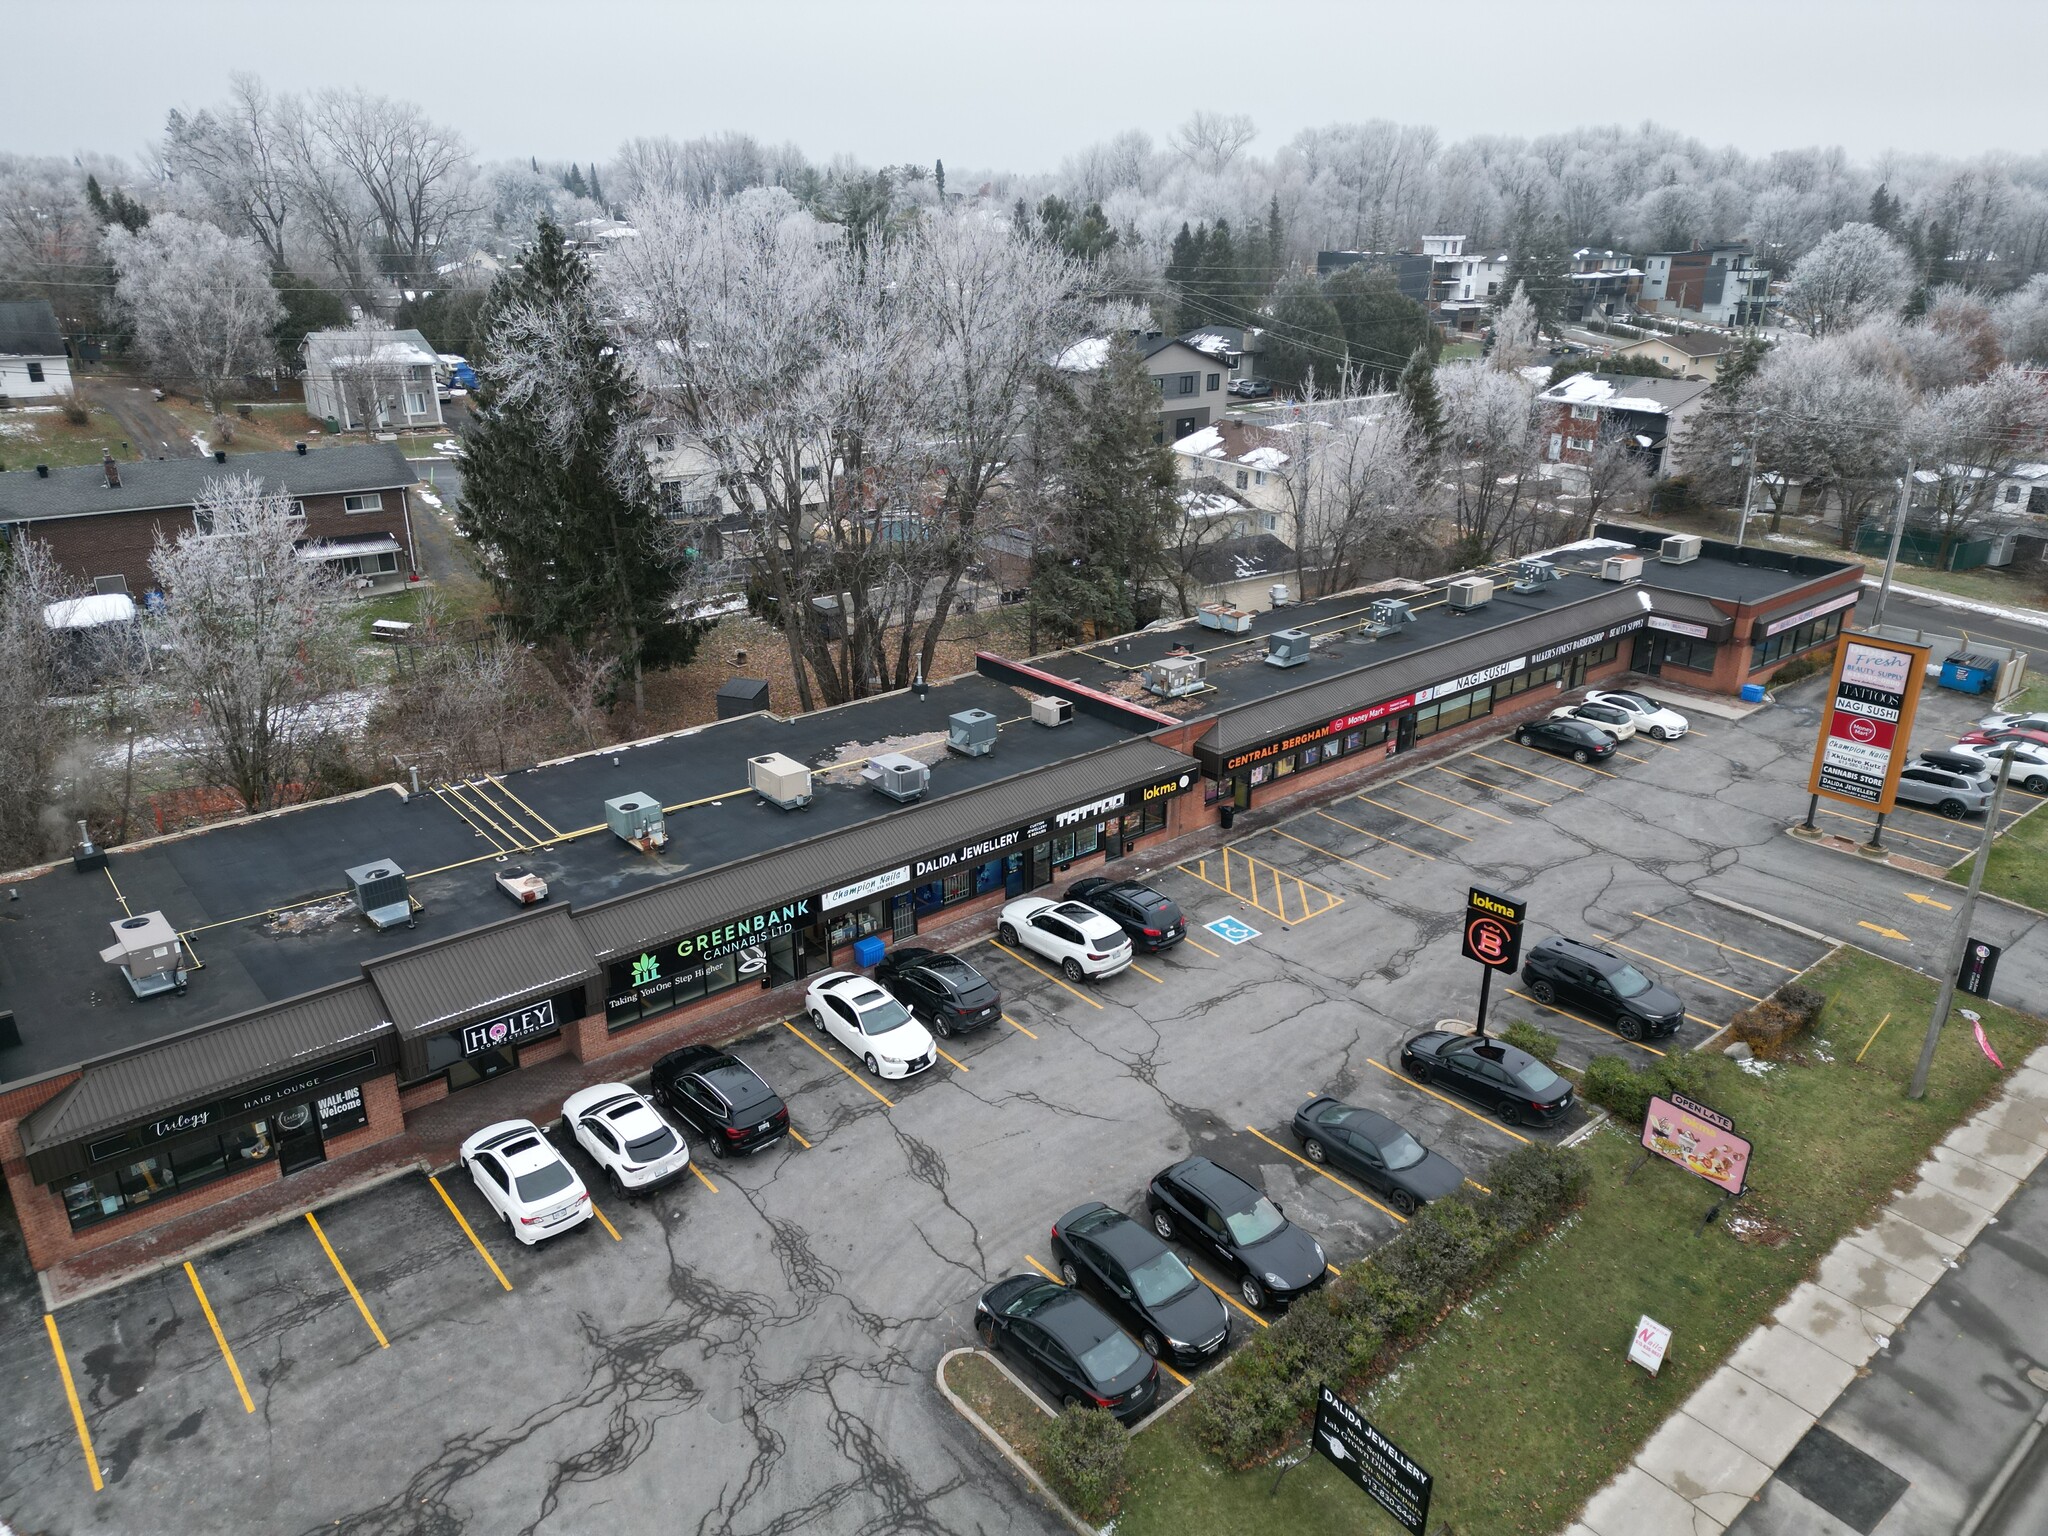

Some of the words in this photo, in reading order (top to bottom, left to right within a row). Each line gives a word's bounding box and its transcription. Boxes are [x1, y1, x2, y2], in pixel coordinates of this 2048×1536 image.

[1847, 664, 1875, 675] BEAUTY
[1877, 670, 1904, 681] SUPPLY
[1856, 654, 1907, 667] Fresh
[1456, 673, 1481, 690] NAGI
[1484, 662, 1511, 680] SUSHI
[1837, 699, 1863, 710] NAGI
[1867, 705, 1897, 719] SUSHI
[1843, 684, 1899, 706] TATTOOS
[1347, 712, 1369, 726] Money
[1369, 707, 1385, 719] Mart
[1853, 723, 1873, 733] Money
[1227, 743, 1279, 770] CENTRALE
[1282, 726, 1330, 751] BERGHAM
[1828, 740, 1866, 755] Champion
[1868, 750, 1889, 761] Nails
[1143, 781, 1177, 800] lokma
[1822, 778, 1844, 788] DALIDA
[1845, 784, 1877, 796] JEWELLERY
[1823, 766, 1858, 780] CANNABIS
[1860, 775, 1883, 787] STORE
[1056, 793, 1125, 828] TATTOO
[916, 852, 957, 876] DALIDA
[960, 831, 1019, 861] JEWELLERY
[832, 880, 876, 901] Champion
[880, 871, 901, 884] Nails
[1473, 892, 1515, 918] lokma
[677, 899, 809, 957] GREENBANK
[703, 931, 767, 961] CANNABIS
[771, 923, 792, 938] LTD
[609, 993, 638, 1009] Taking
[640, 987, 656, 998] You
[656, 981, 672, 992] One
[675, 974, 693, 985] Step
[471, 1006, 547, 1048] HOLEY
[481, 1026, 539, 1050] CONFECTIONS
[244, 1095, 271, 1109] HAIR
[277, 1078, 320, 1098] LOUNGE
[317, 1087, 360, 1109] WALK-INS
[319, 1098, 361, 1119] Welcome
[1675, 1096, 1702, 1113] OPEN
[1704, 1109, 1729, 1127] LATE
[149, 1109, 210, 1137] Trilogy
[1682, 1113, 1717, 1137] lokma
[1324, 1388, 1362, 1430] DALIDA
[1365, 1427, 1428, 1484] JEWELLERY
[1324, 1416, 1340, 1433] Lab
[1341, 1431, 1369, 1460] Grown
[1371, 1457, 1419, 1502] Diamonds!
[1346, 1427, 1366, 1447] Now
[1366, 1445, 1397, 1476] Selling
[1362, 1475, 1417, 1526] 613-830-6445
[1392, 1486, 1422, 1516] Repairs
